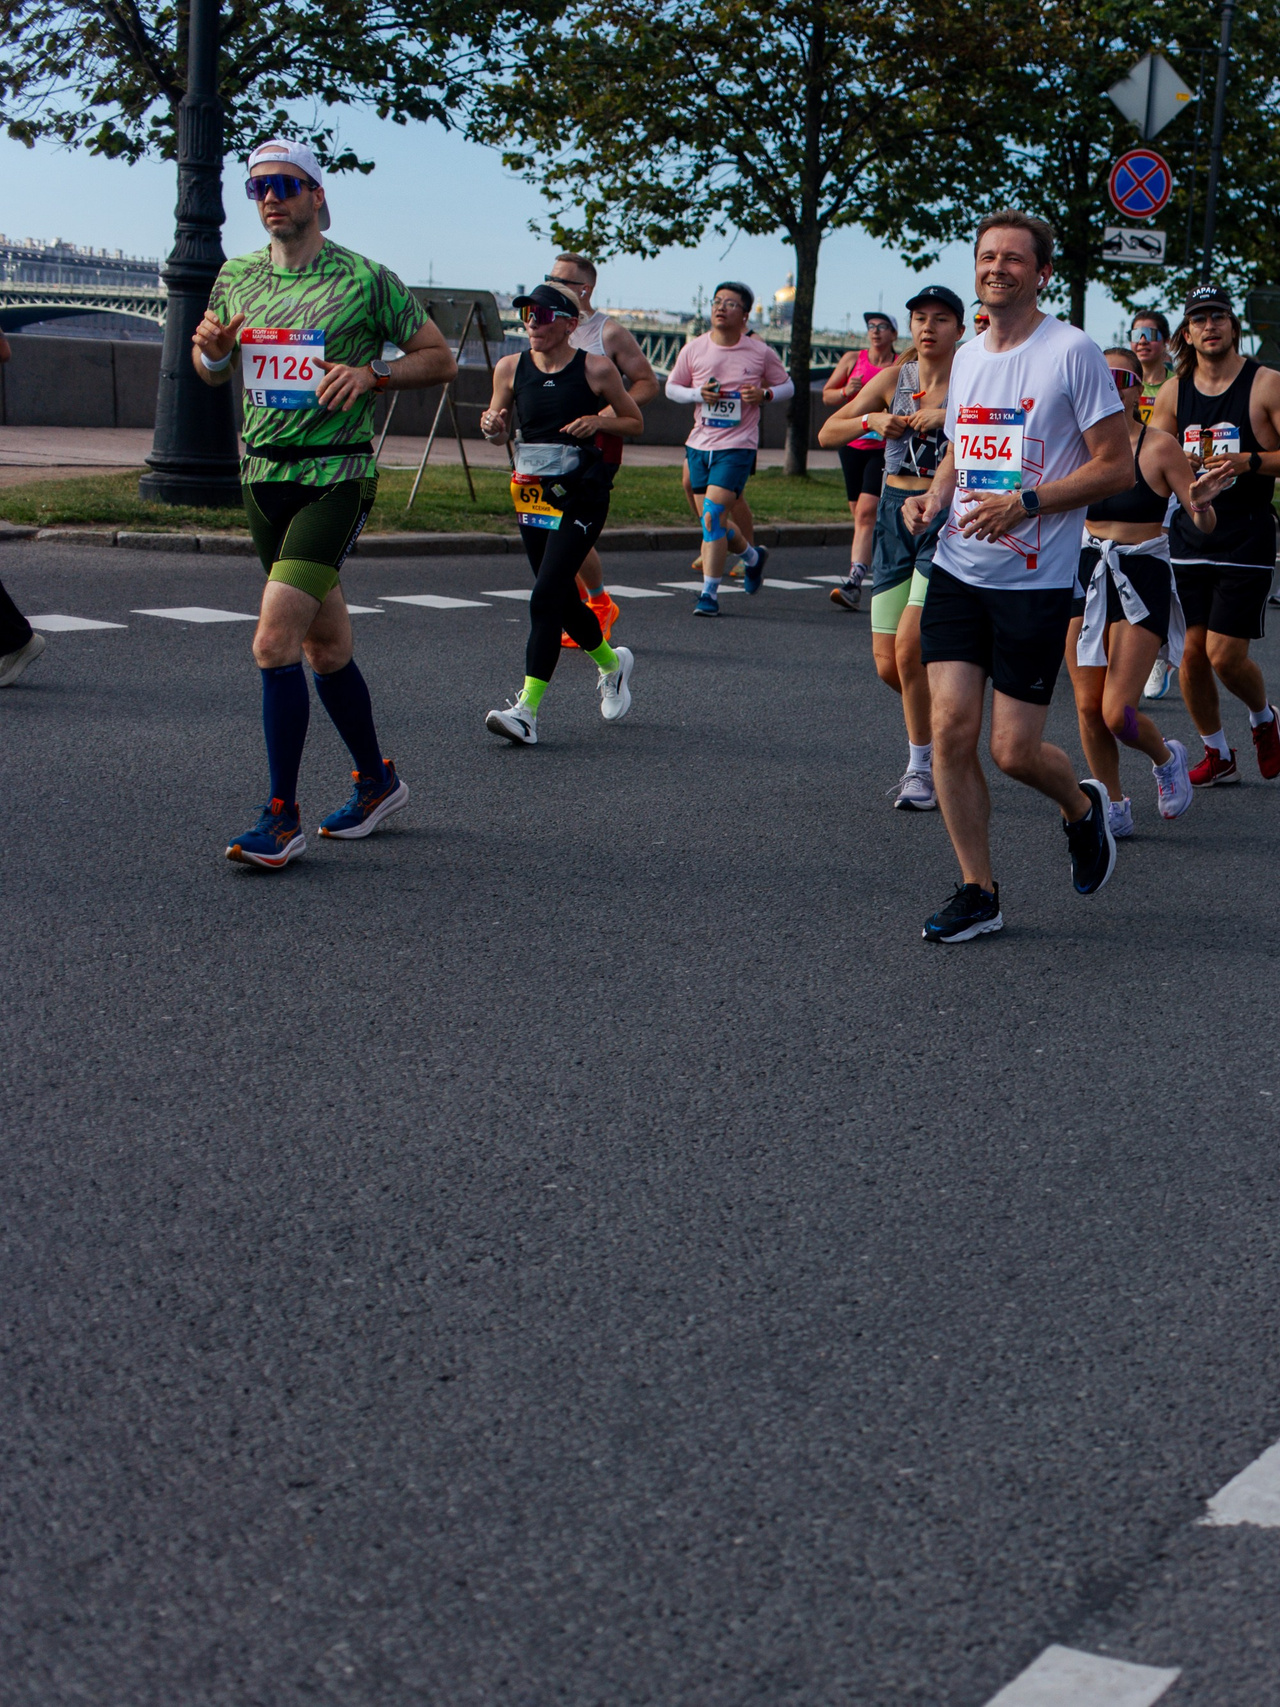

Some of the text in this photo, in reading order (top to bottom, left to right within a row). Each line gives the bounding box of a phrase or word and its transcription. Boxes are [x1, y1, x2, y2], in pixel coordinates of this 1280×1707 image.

[1192, 287, 1217, 298] JAPAN
[252, 355, 313, 381] 7126
[255, 392, 264, 405] E
[960, 435, 1012, 461] 7454
